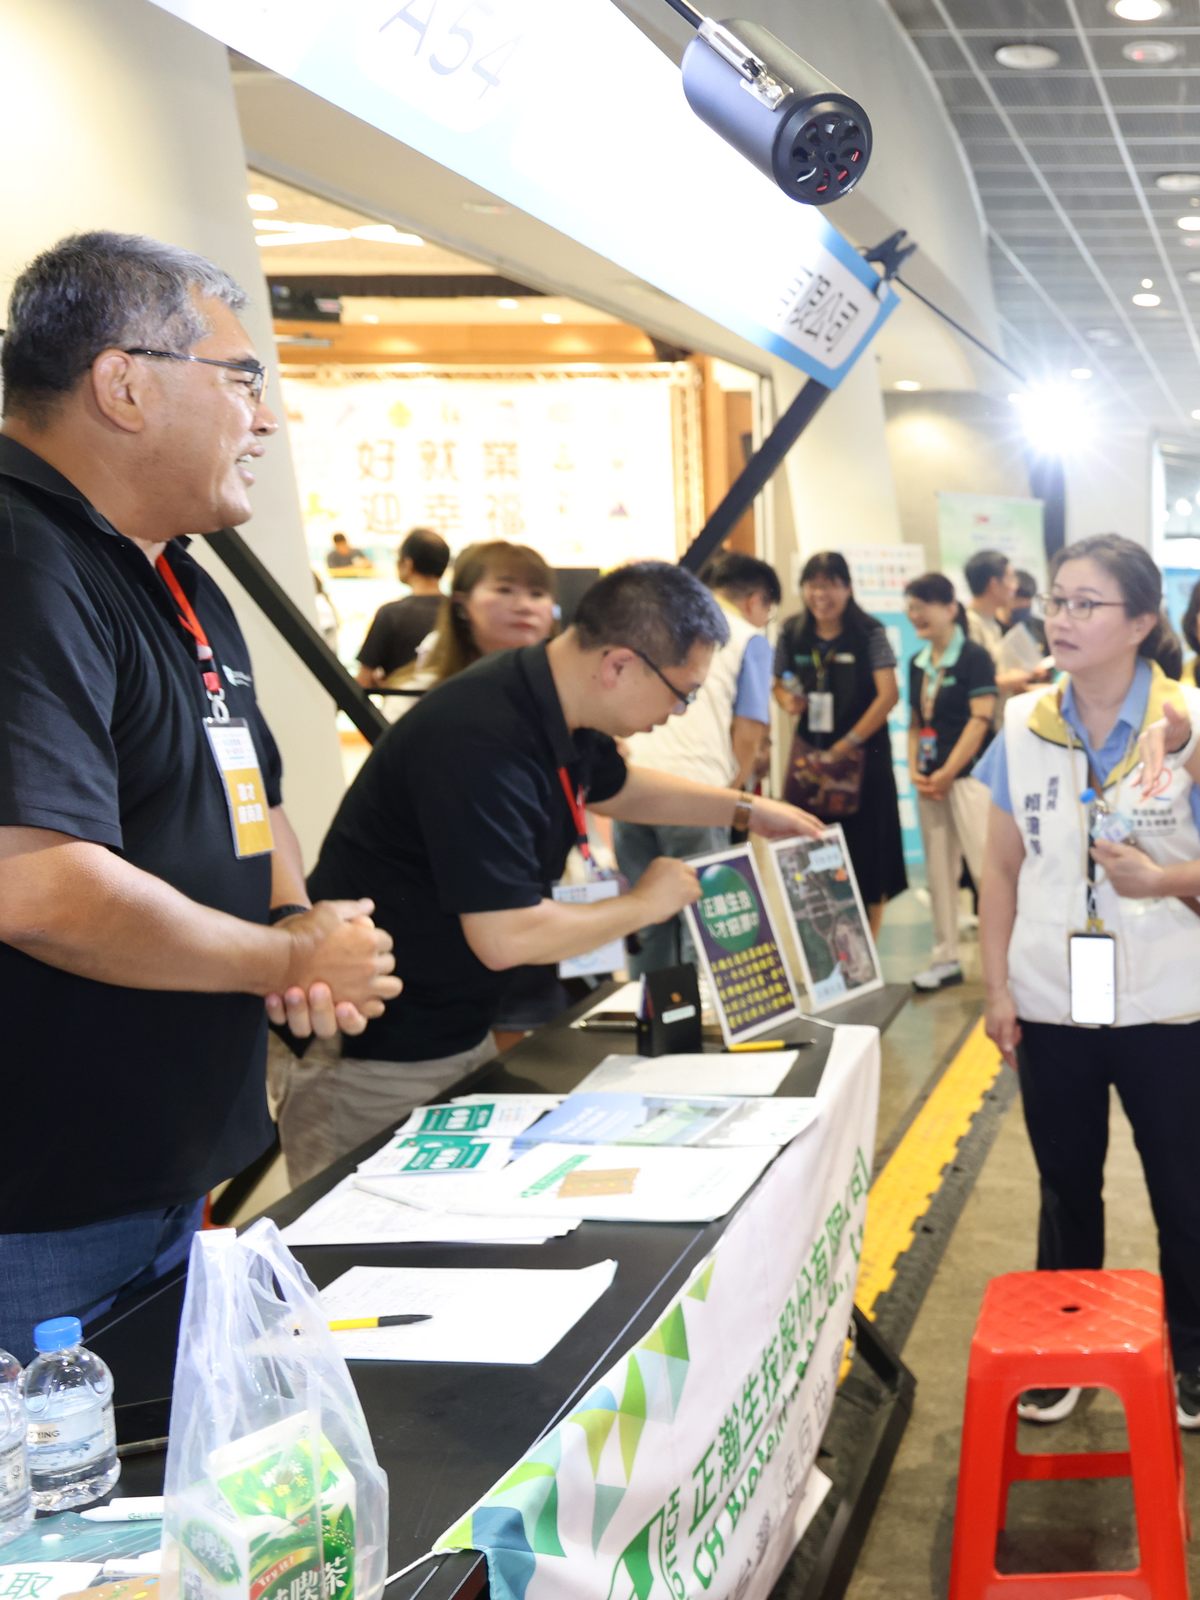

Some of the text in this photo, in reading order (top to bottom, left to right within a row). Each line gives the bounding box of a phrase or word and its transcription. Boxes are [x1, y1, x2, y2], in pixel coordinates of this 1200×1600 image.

[379, 0, 524, 100] A54
[356, 438, 521, 482] 好就業
[361, 493, 526, 534] 迎幸福
[688, 1145, 871, 1537] 正瀚生技股份有限司
[0, 1571, 54, 1600] 取
